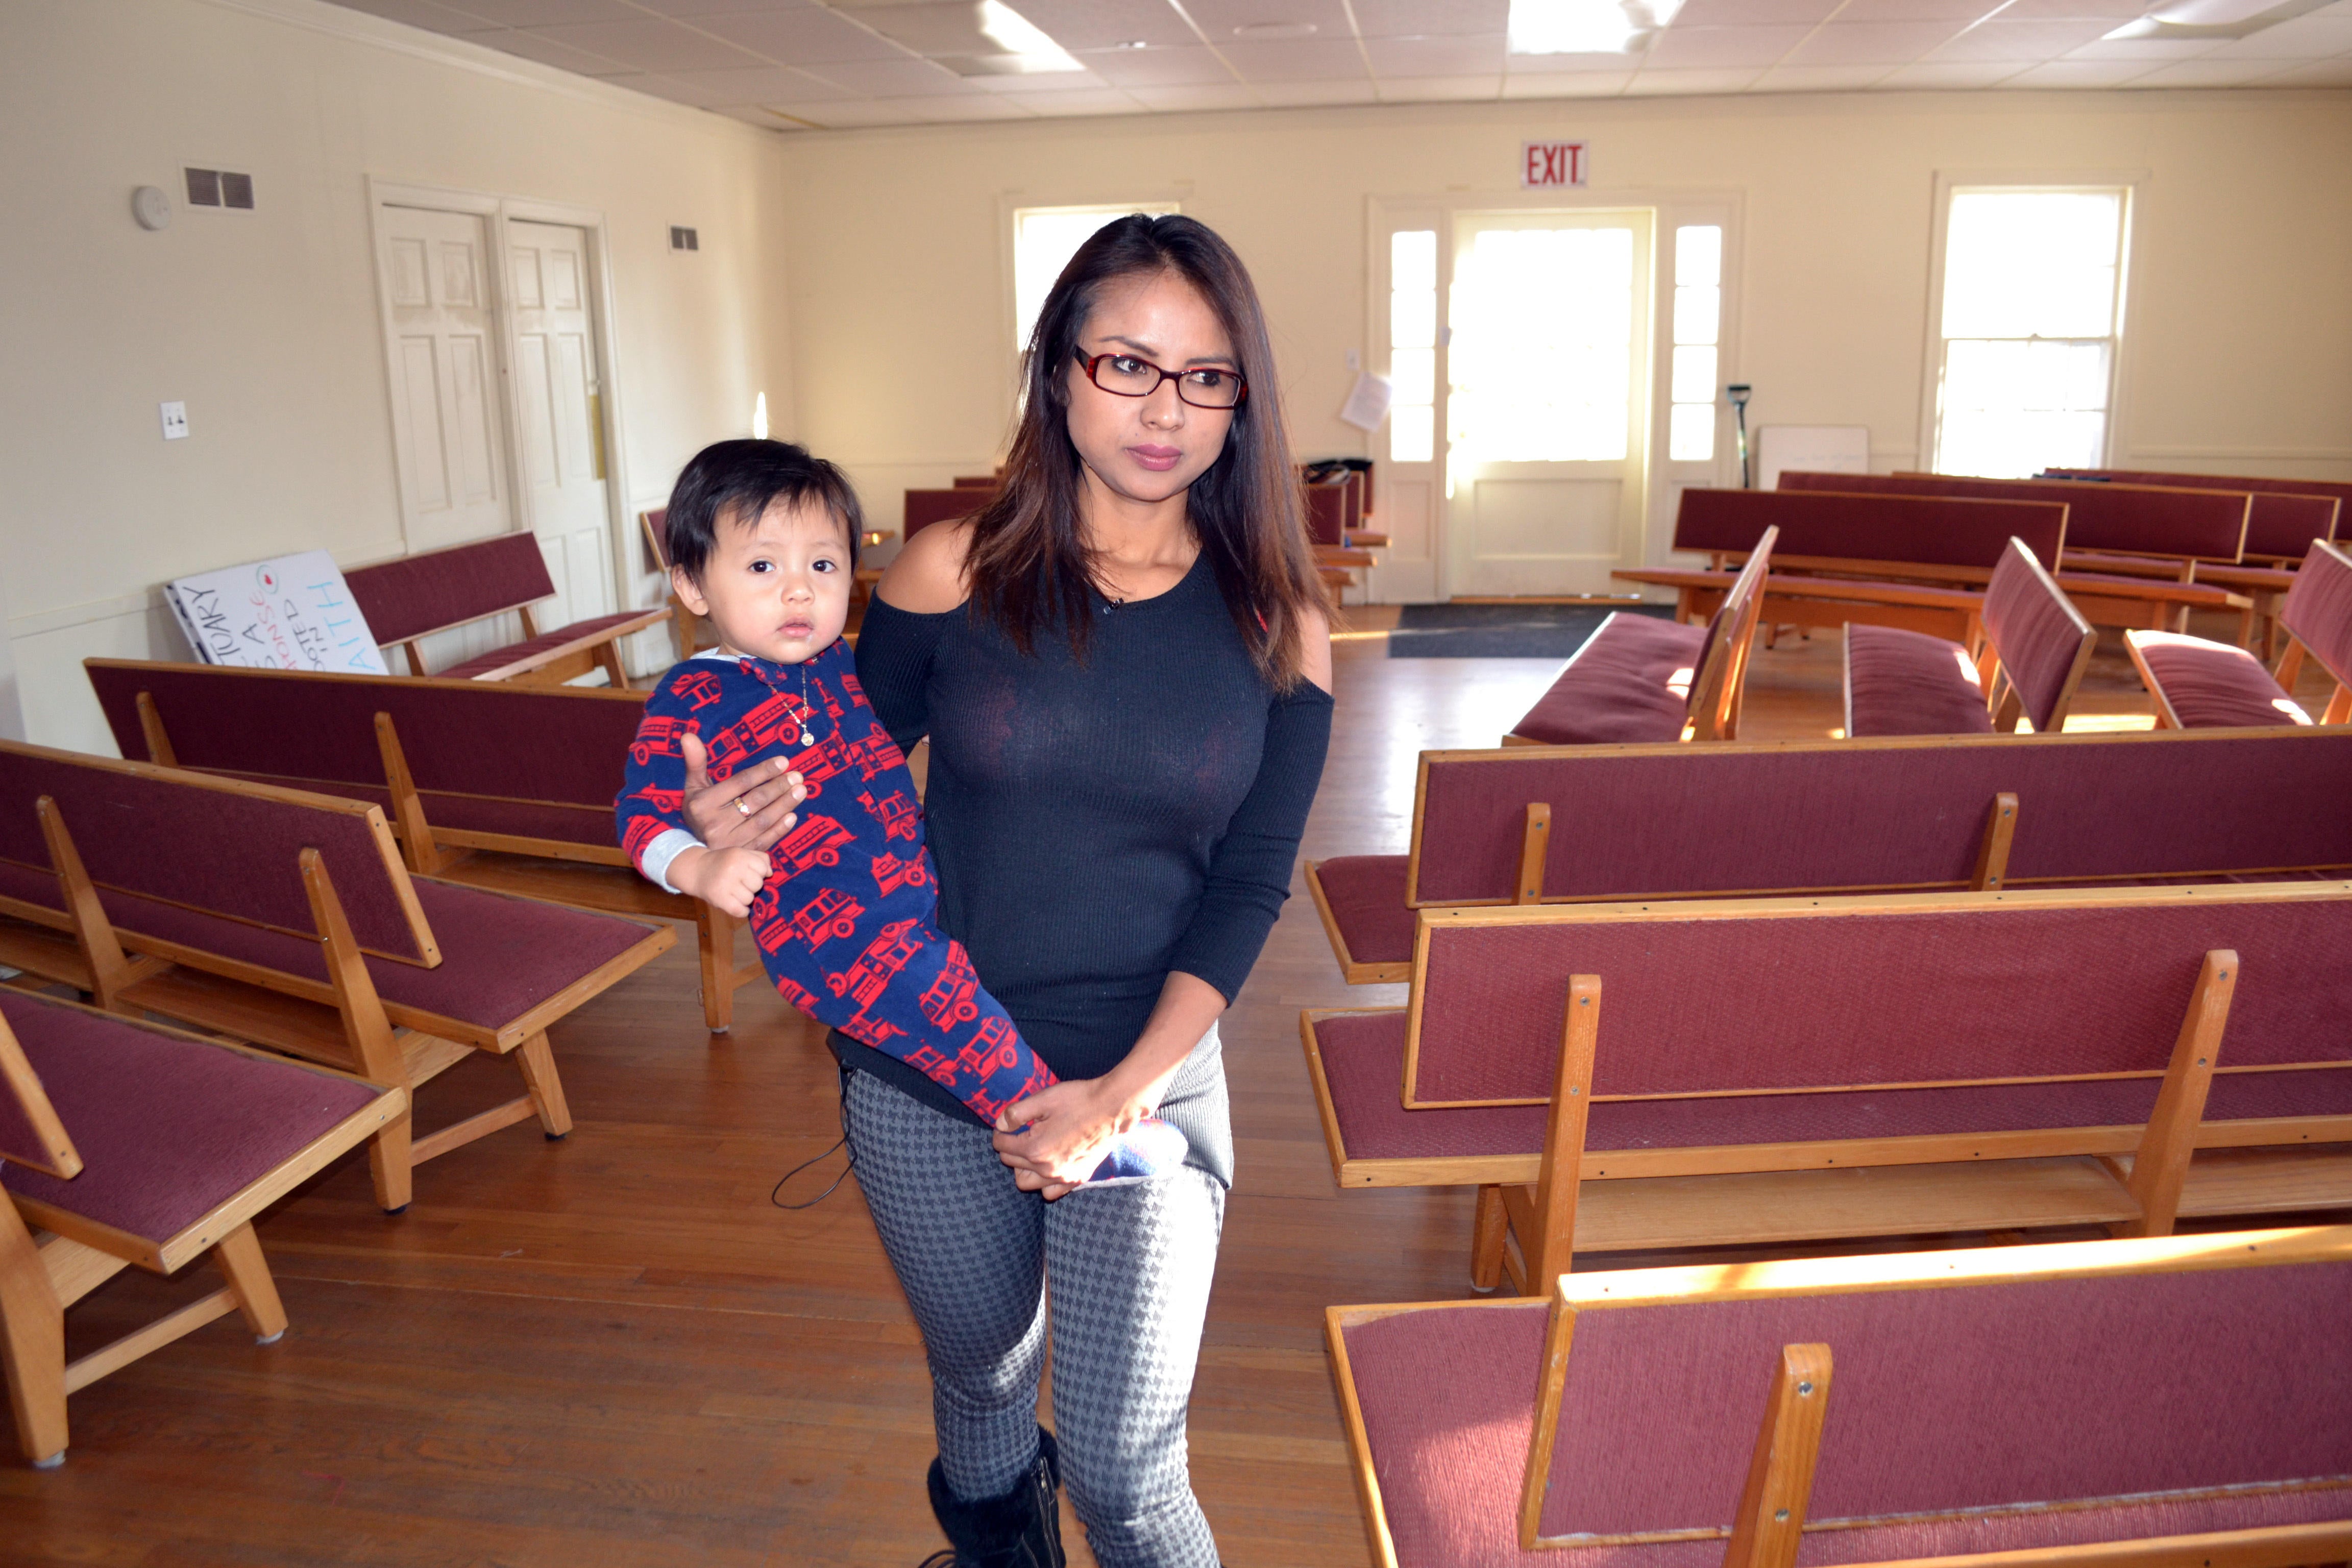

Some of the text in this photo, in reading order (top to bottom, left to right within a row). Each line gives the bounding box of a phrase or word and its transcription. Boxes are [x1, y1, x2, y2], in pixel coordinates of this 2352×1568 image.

[1528, 144, 1582, 184] EXIT
[183, 586, 247, 667] TUARY
[242, 623, 264, 644] A
[307, 581, 377, 670] AITH
